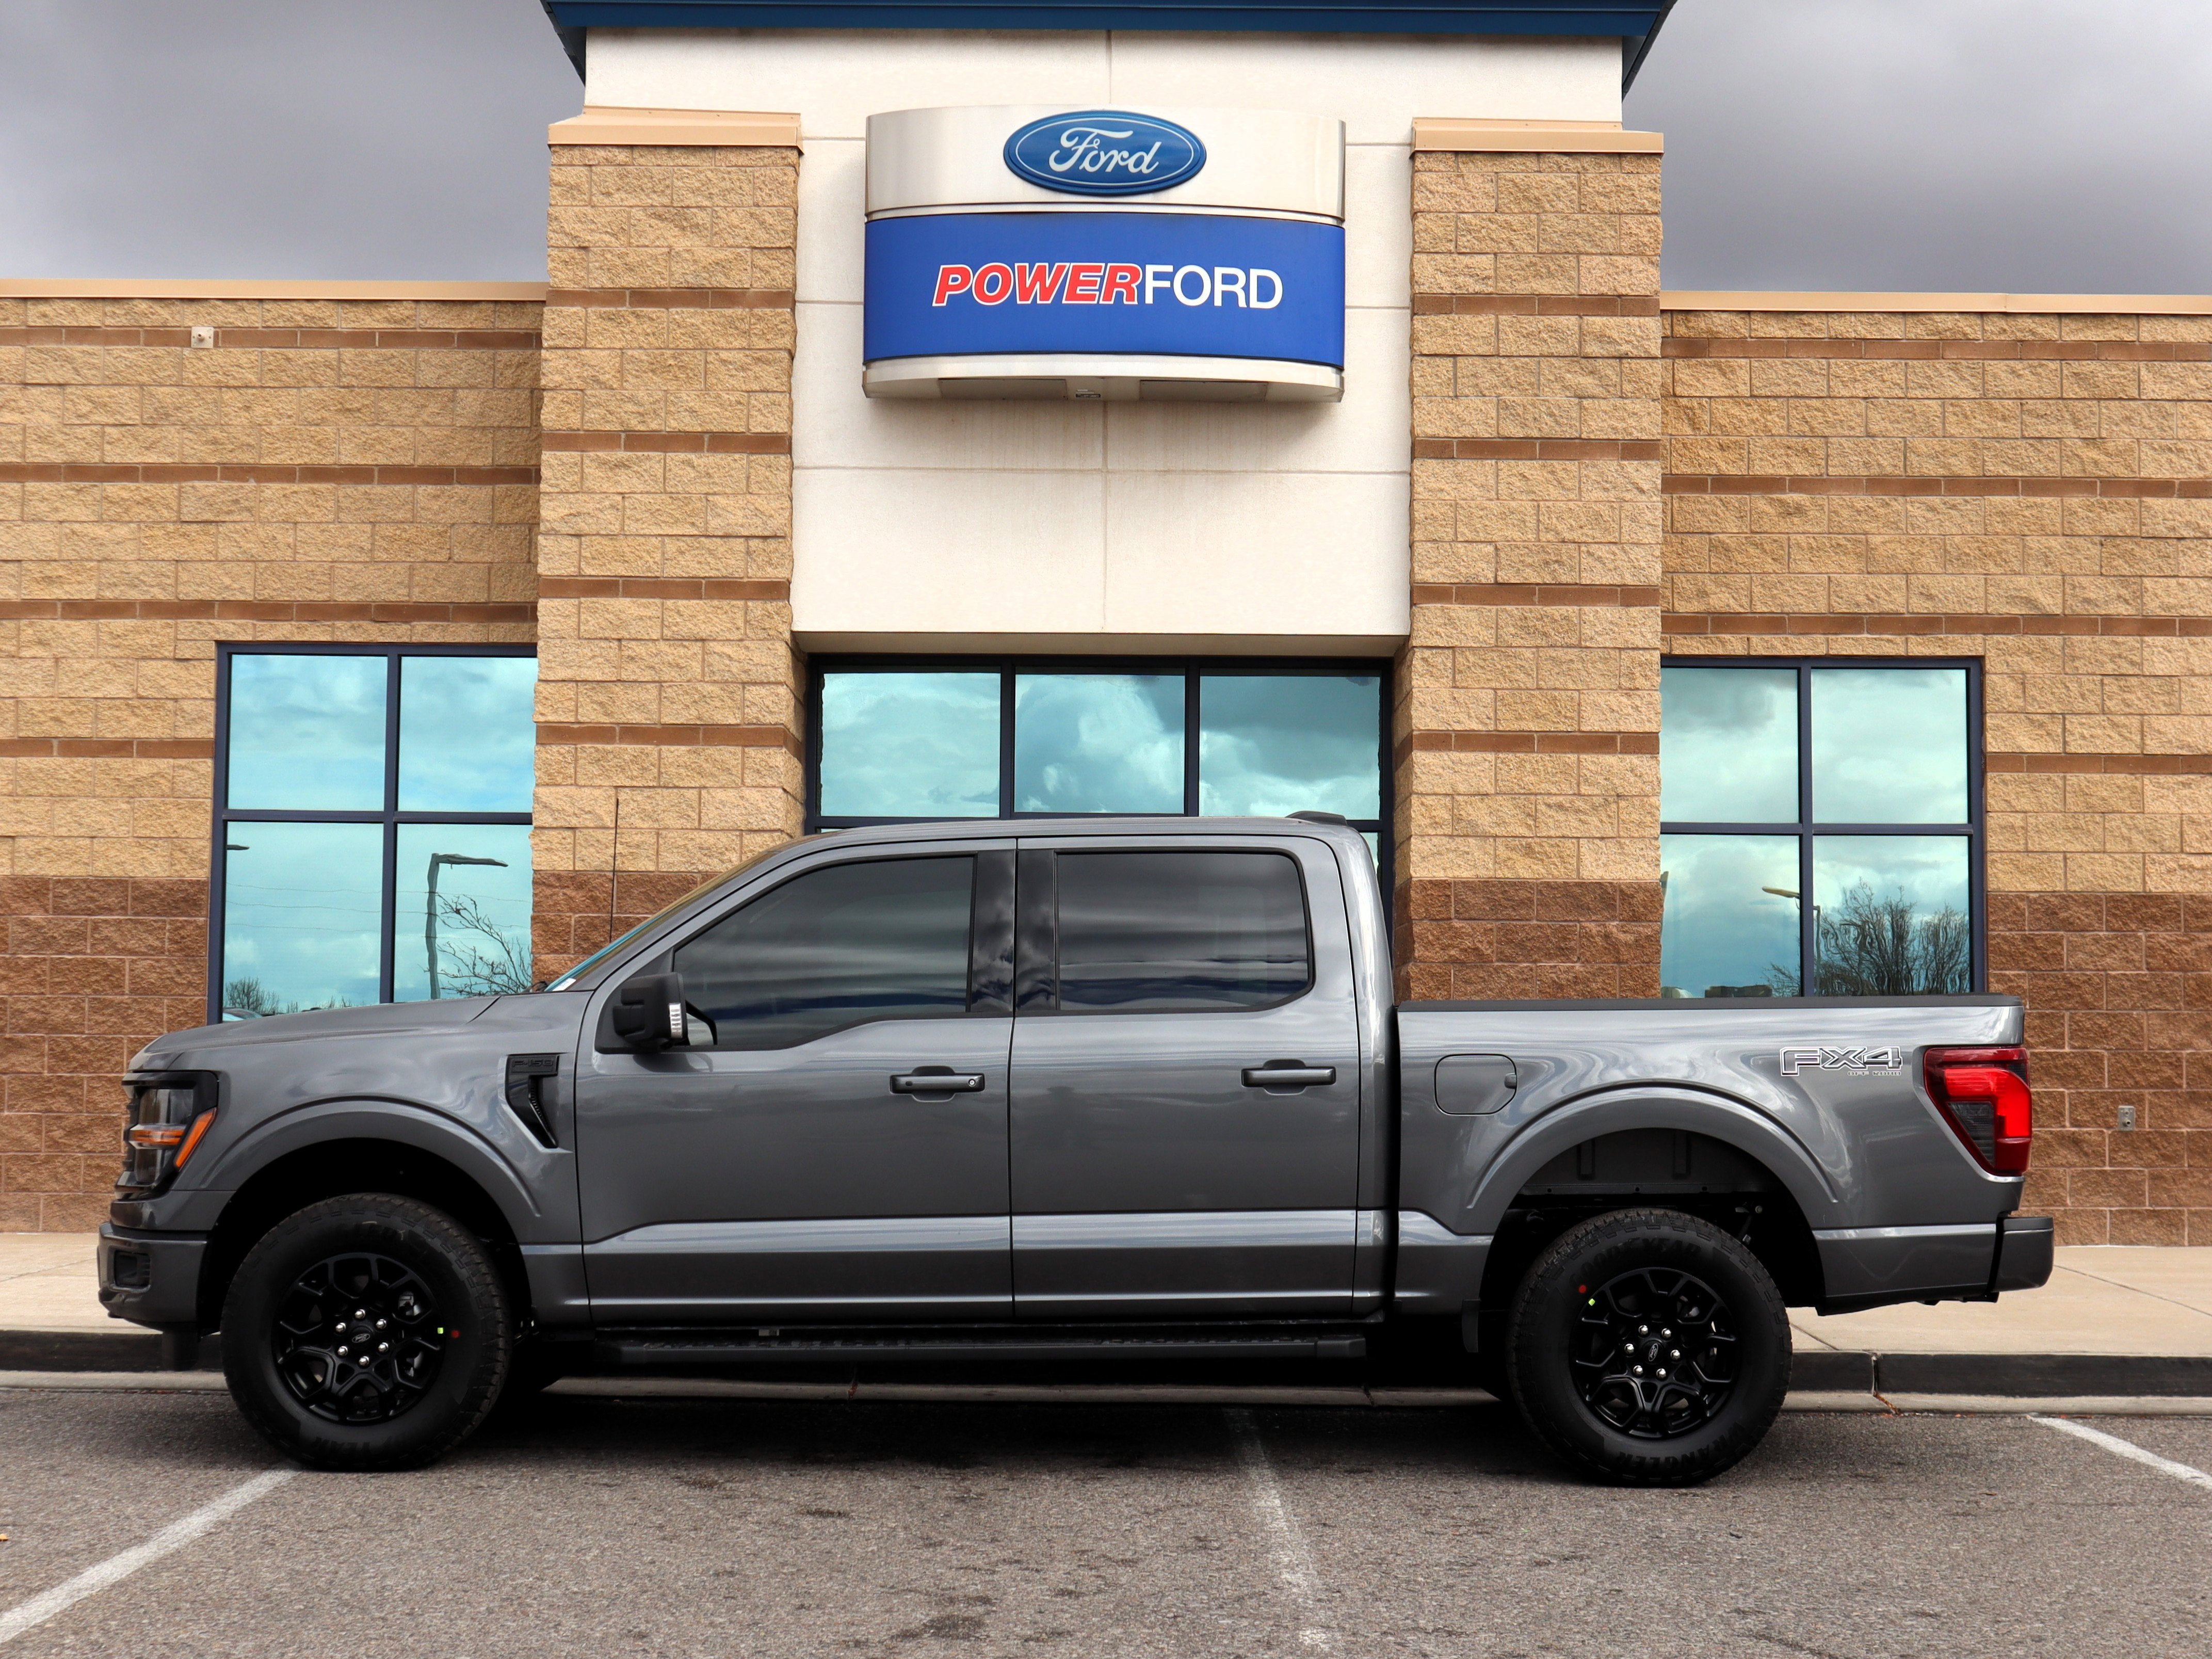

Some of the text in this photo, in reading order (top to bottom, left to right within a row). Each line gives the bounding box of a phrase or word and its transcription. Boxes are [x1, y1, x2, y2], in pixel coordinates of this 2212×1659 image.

[1048, 126, 1161, 174] Ford
[511, 1058, 554, 1068] F-150
[1780, 1046, 1902, 1076] FX4
